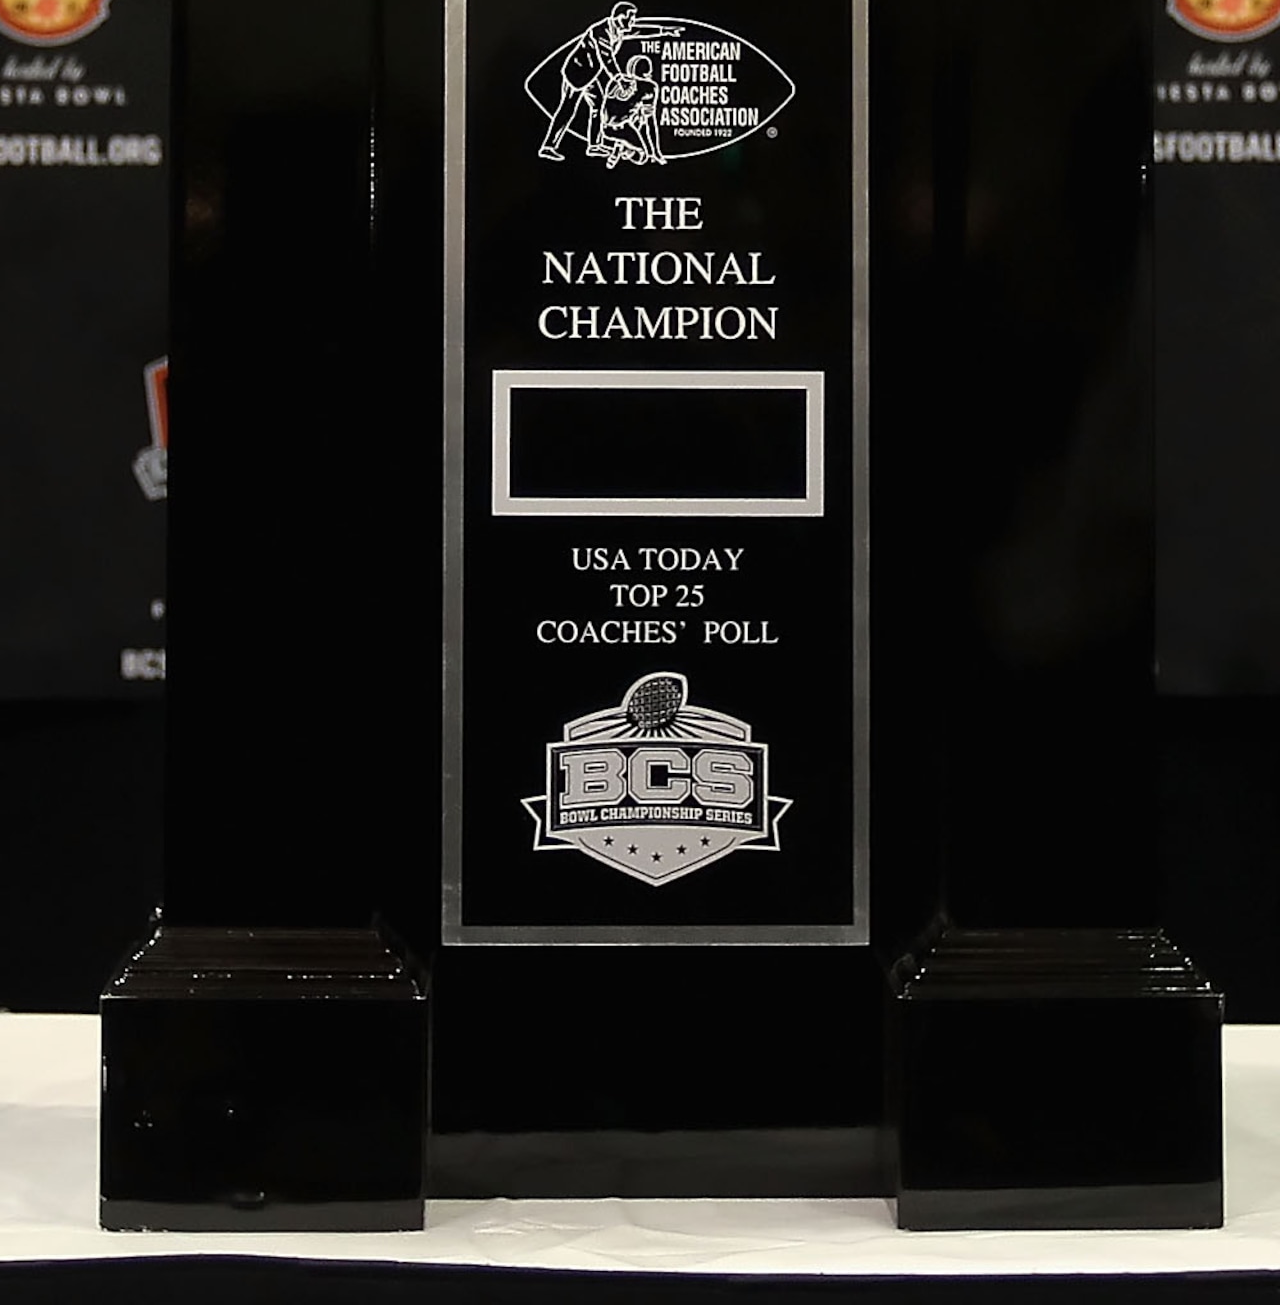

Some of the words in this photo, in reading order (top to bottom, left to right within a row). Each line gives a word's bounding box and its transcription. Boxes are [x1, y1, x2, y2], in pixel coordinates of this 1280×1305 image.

[640, 40, 661, 54] THE
[661, 41, 741, 61] AMERICAN
[661, 63, 737, 83] FOOTBALL
[54, 84, 126, 107] BOWL
[661, 85, 729, 105] COACHES
[660, 107, 759, 127] ASSOCIATION
[673, 128, 713, 138] FOUNDED
[714, 128, 733, 138] 1922
[614, 196, 704, 230] THE
[541, 250, 777, 286] NATIONAL
[537, 305, 780, 341] CHAMPION
[571, 547, 632, 572] USA
[638, 547, 745, 572] TODAY
[609, 583, 669, 608] TOP
[674, 583, 706, 608] 25
[536, 619, 687, 644] COACHES'
[703, 620, 780, 644] POLL
[558, 747, 755, 810] BCS
[559, 807, 599, 826] BOWL
[600, 806, 703, 822] CHAMPIONSHIP
[705, 806, 753, 825] SERIES
